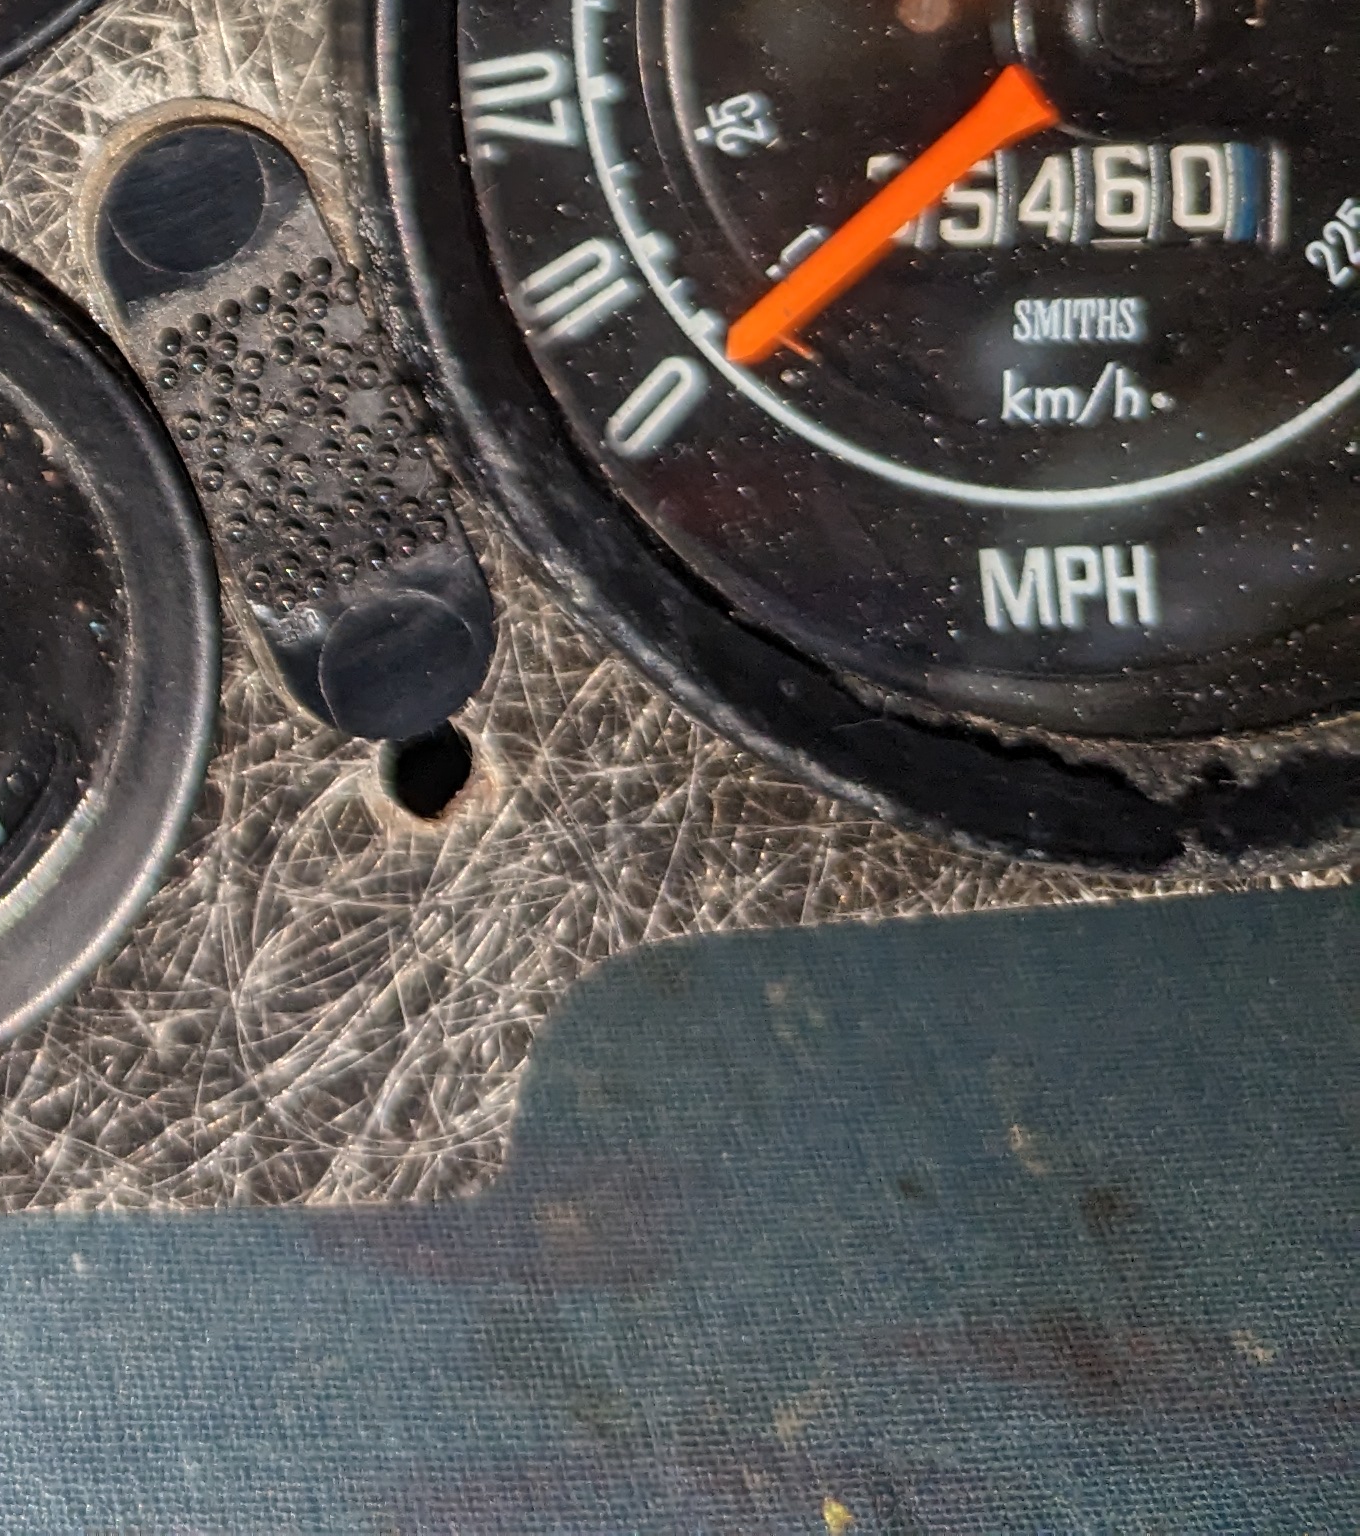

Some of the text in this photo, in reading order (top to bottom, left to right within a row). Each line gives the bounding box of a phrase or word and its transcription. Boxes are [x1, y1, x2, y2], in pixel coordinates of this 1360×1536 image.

[716, 91, 772, 156] 25
[866, 141, 1225, 246] 5460
[523, 238, 636, 342] 10
[1013, 298, 1141, 342] SMITHS
[608, 357, 703, 457] 0
[979, 545, 1160, 631] MPH
